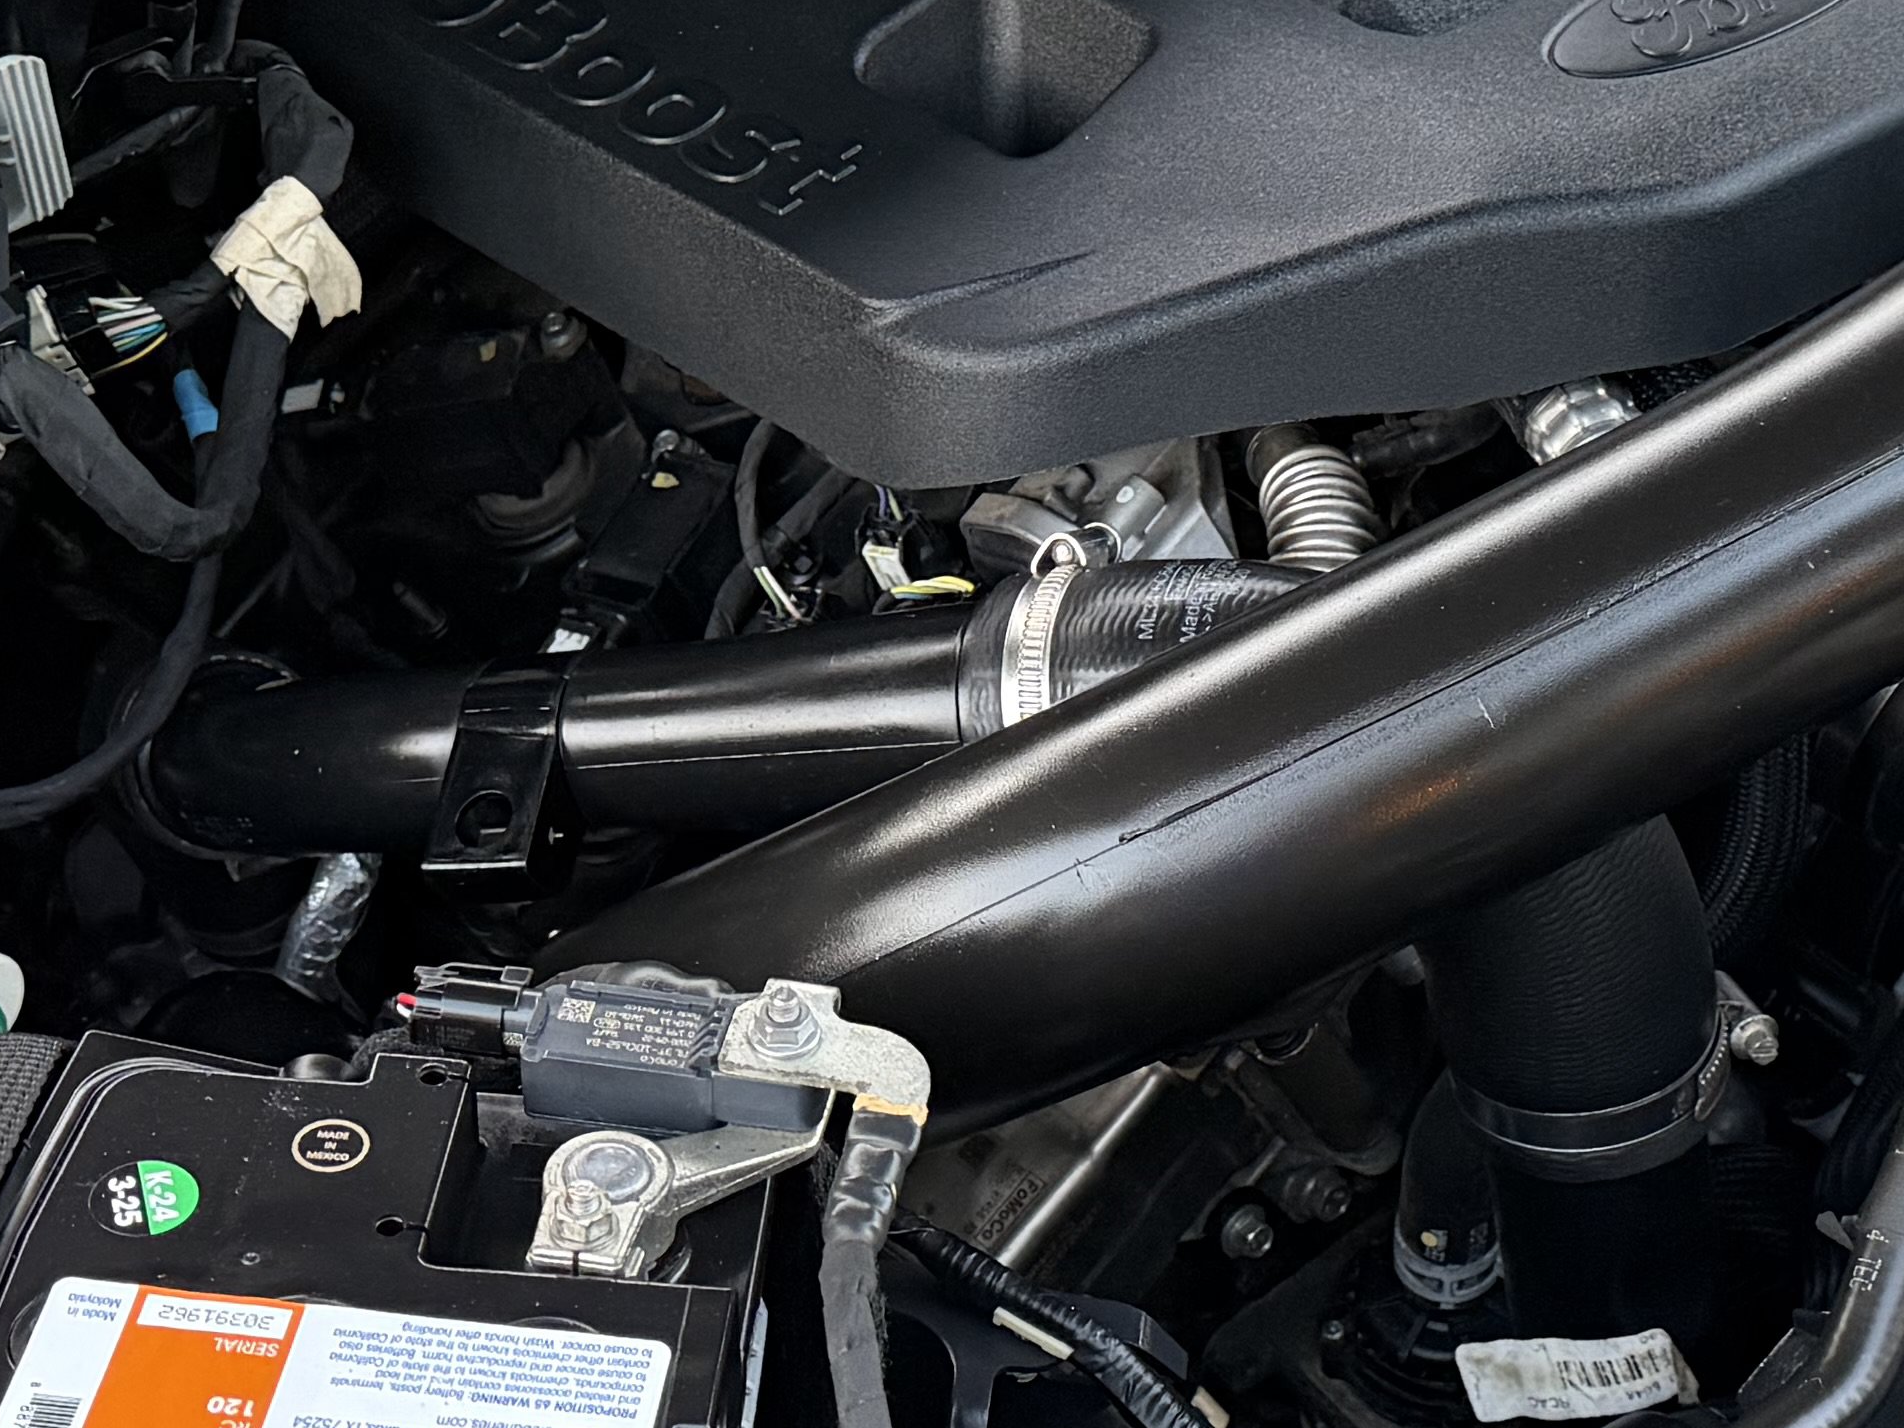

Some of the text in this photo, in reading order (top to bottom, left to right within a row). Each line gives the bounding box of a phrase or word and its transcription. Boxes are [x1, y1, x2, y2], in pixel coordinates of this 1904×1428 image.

[316, 1129, 350, 1141] MADE
[325, 1141, 338, 1151] IN
[306, 1150, 351, 1162] MEXICO
[108, 1173, 141, 1227] 3-25
[139, 1166, 173, 1226] K-24
[979, 1177, 1041, 1242] FoMoCo
[67, 1292, 122, 1308] Malaysia
[66, 1305, 116, 1321] Made in
[157, 1304, 274, 1330] 30391962
[454, 1329, 481, 1340] after
[484, 1332, 520, 1345] hands
[213, 1336, 279, 1357] SERIAL
[332, 1327, 650, 1369] contain other chemicals known to the state of California
[338, 1340, 363, 1351] also
[522, 1336, 554, 1349] Wash
[366, 1343, 416, 1359] Batteries
[603, 1344, 639, 1355] cause
[640, 1348, 653, 1358] to
[328, 1351, 384, 1367] California
[385, 1358, 399, 1368] of
[455, 1353, 527, 1368] reproductive
[401, 1360, 430, 1372] state
[432, 1363, 451, 1374] the
[453, 1365, 465, 1376] to
[528, 1362, 552, 1372] and
[554, 1364, 595, 1376] cancer
[468, 1367, 507, 1380] known
[509, 1371, 569, 1386] chemicals
[596, 1368, 633, 1379] cause
[634, 1372, 646, 1382] to
[329, 1376, 384, 1390] terminals
[374, 1369, 641, 1405] and related accessories contain and lead
[423, 1384, 464, 1401] Battery
[206, 1395, 253, 1417] 120
[470, 1391, 530, 1408] WARNING:
[534, 1398, 551, 1409] 65
[553, 1400, 637, 1419] PROPOSITION
